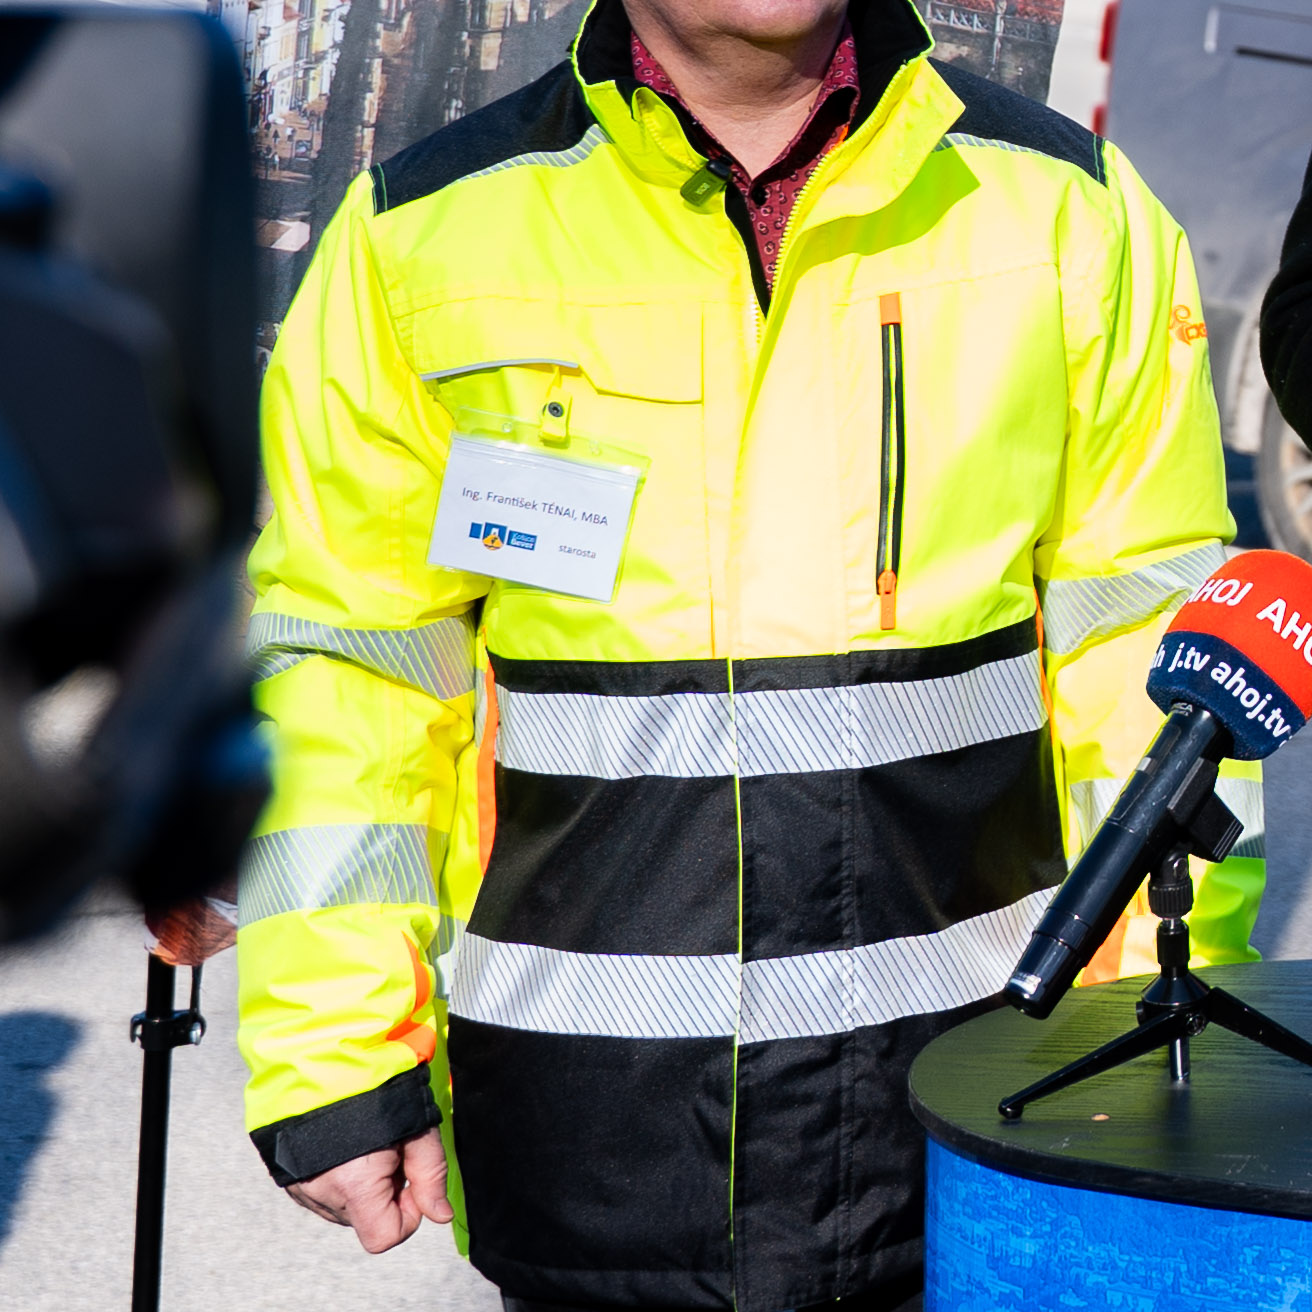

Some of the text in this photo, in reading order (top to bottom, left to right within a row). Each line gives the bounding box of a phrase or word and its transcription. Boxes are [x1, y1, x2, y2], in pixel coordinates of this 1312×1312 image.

[462, 487, 482, 501] Ing.
[486, 491, 538, 511] František
[581, 511, 609, 526] MBA
[559, 545, 597, 559] starosta
[1211, 661, 1292, 738] ahoj.tv
